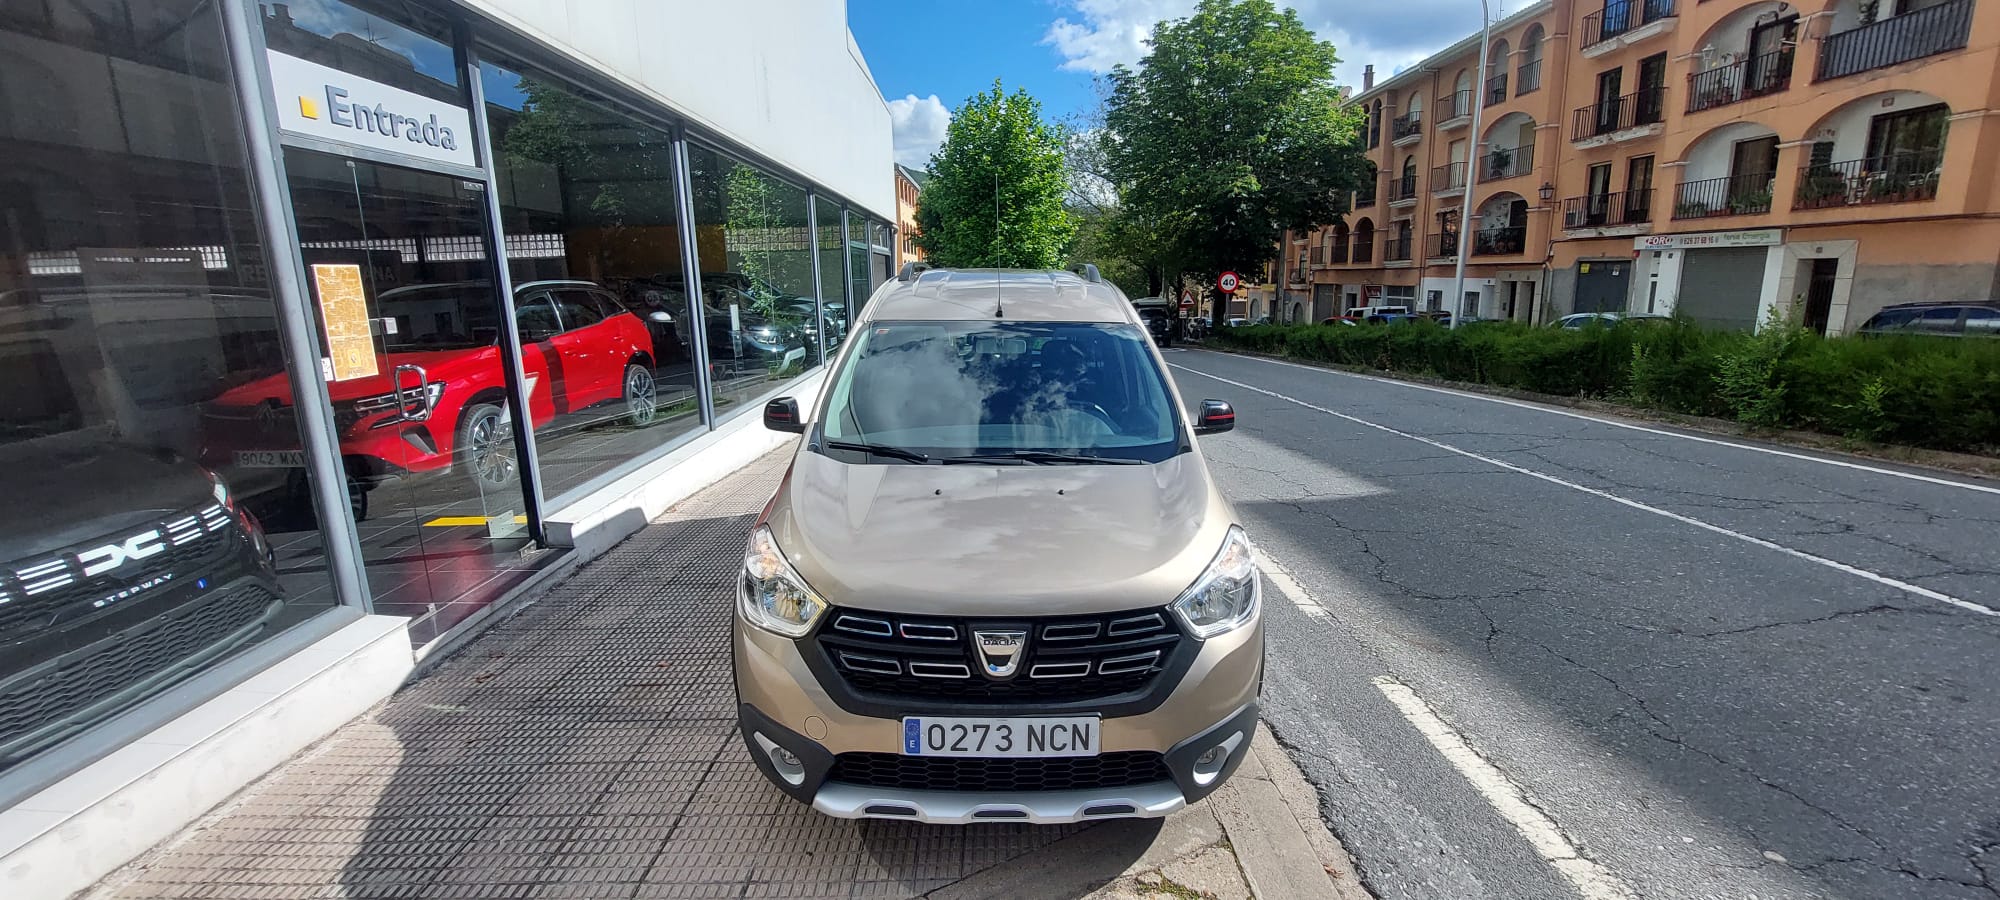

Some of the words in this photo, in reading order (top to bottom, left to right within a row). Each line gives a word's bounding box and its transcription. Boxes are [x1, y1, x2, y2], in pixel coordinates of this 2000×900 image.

[325, 85, 457, 150] Entrada
[1222, 278, 1235, 287] 40
[241, 452, 275, 466] 9042
[94, 573, 172, 607] STEPWAY
[910, 740, 916, 748] E
[927, 723, 1013, 752] 0273
[1027, 723, 1090, 752] NCN
